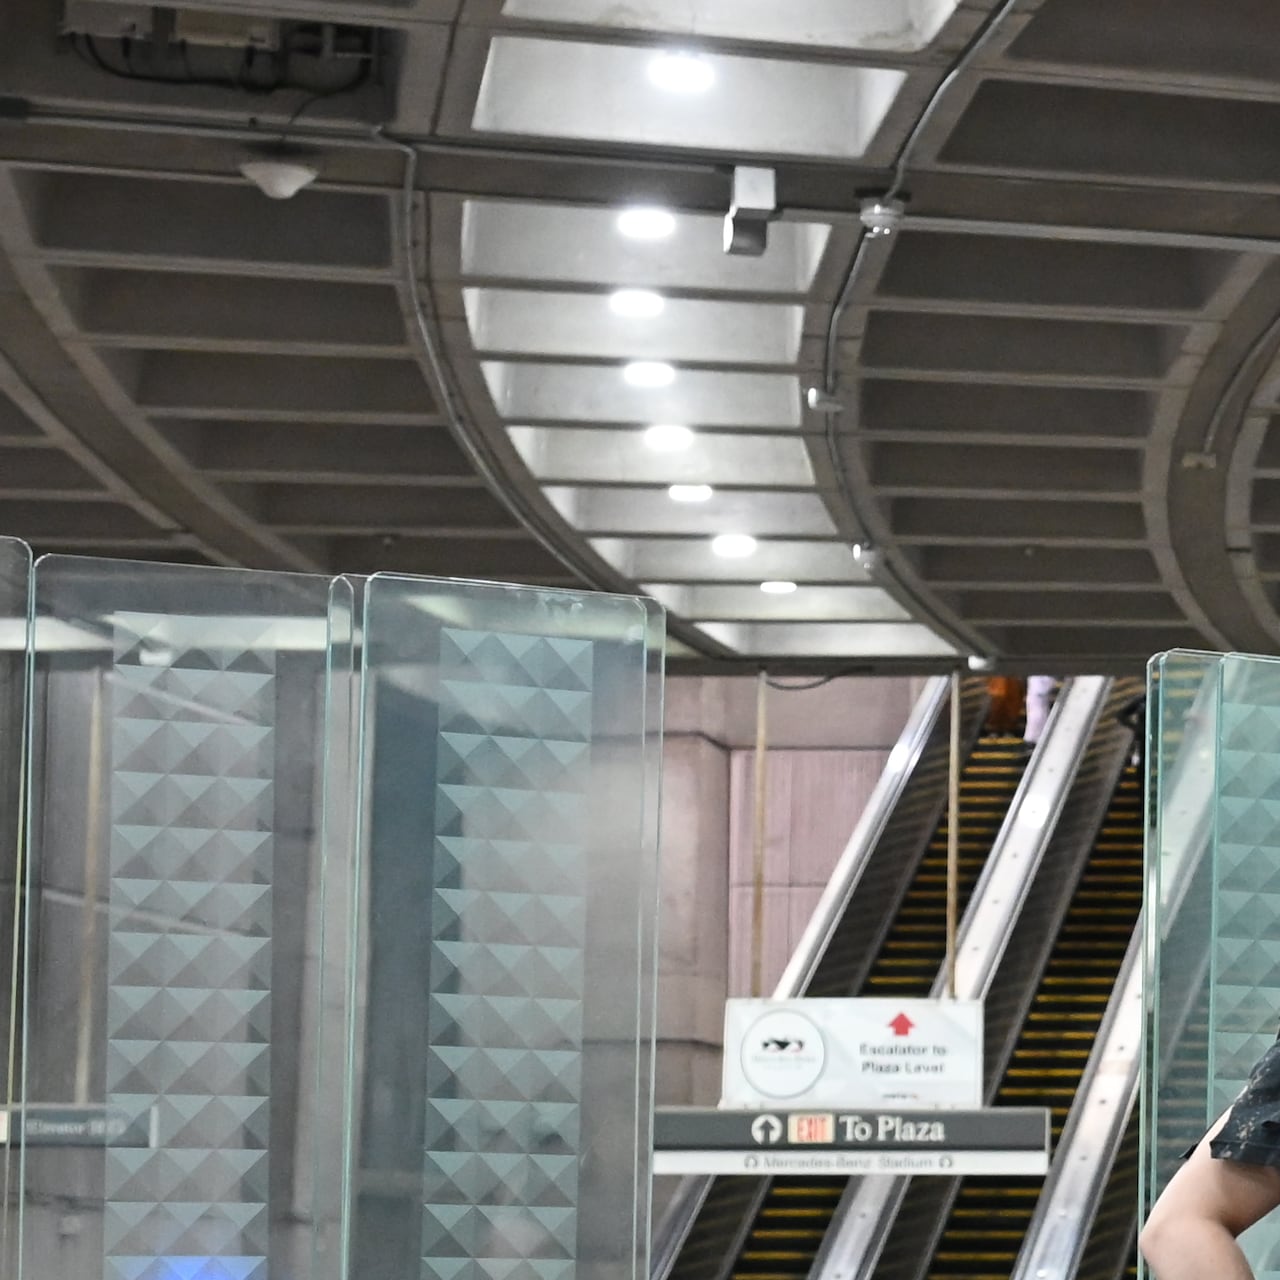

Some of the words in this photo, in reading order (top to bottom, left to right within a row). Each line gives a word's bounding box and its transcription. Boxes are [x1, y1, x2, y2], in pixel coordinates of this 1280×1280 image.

[859, 1043, 927, 1056] Escalator
[932, 1044, 948, 1056] to
[861, 1062, 900, 1075] Plaza
[905, 1063, 945, 1074] Level
[796, 1117, 828, 1142] EXIT
[839, 1115, 872, 1141] To
[876, 1115, 946, 1142] Plaza
[763, 1157, 871, 1169] Mercedes-Benz
[878, 1157, 933, 1168] Stadium
